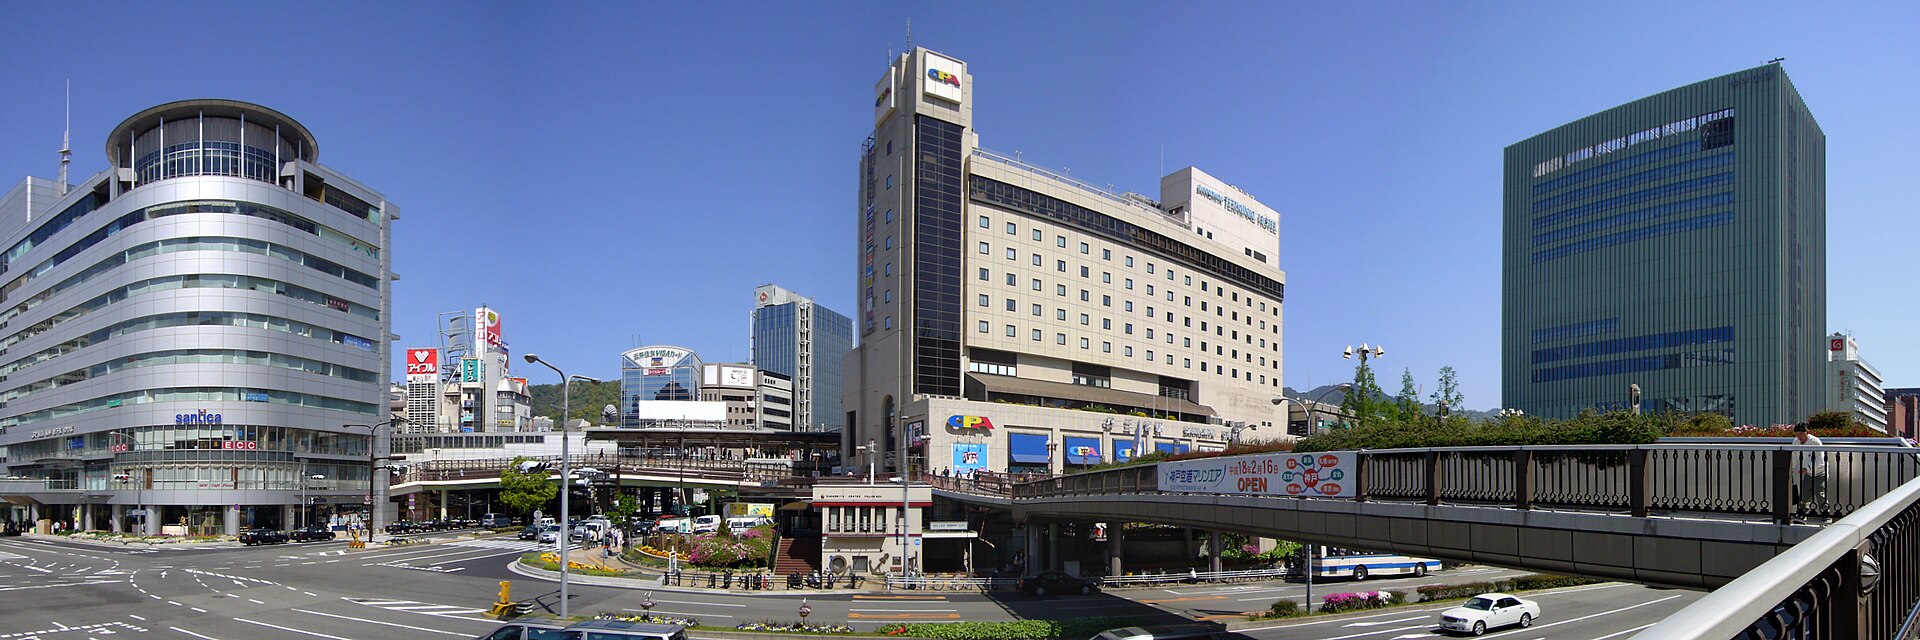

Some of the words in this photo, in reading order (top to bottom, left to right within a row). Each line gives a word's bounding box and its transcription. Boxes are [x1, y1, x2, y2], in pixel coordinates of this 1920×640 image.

[408, 363, 436, 373] アイフル
[175, 409, 222, 424] santica
[225, 441, 255, 449] ECC
[1229, 459, 1279, 475] 平成18年2月16日
[1169, 469, 1222, 483] 神戸空港マリンエア
[1304, 472, 1318, 483] 神戸
[1237, 477, 1267, 493] OPEN
